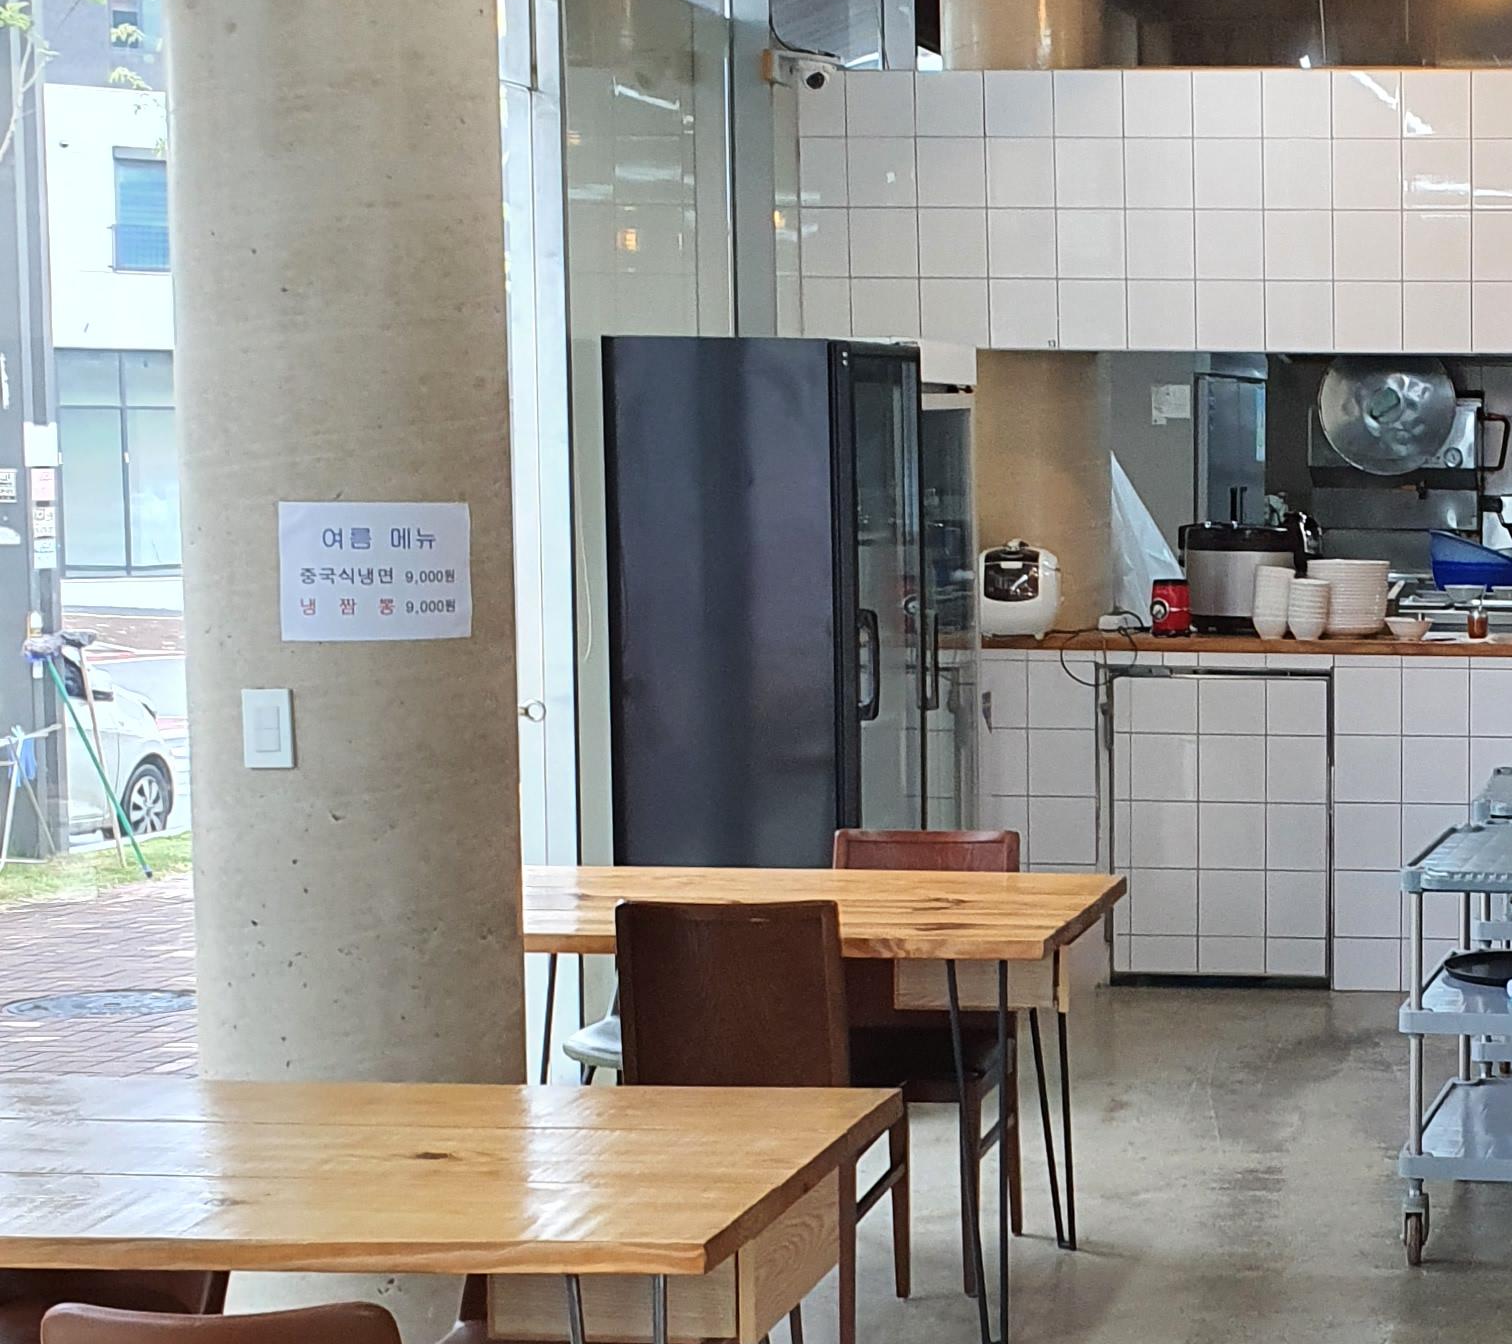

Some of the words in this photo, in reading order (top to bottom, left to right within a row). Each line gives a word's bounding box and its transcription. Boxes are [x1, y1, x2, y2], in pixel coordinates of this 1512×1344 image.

[322, 527, 371, 549] 여름
[391, 527, 436, 549] 메뉴
[300, 567, 393, 585] 중국식냉면
[405, 569, 455, 585] 9,000원
[405, 599, 456, 615] 9,000원
